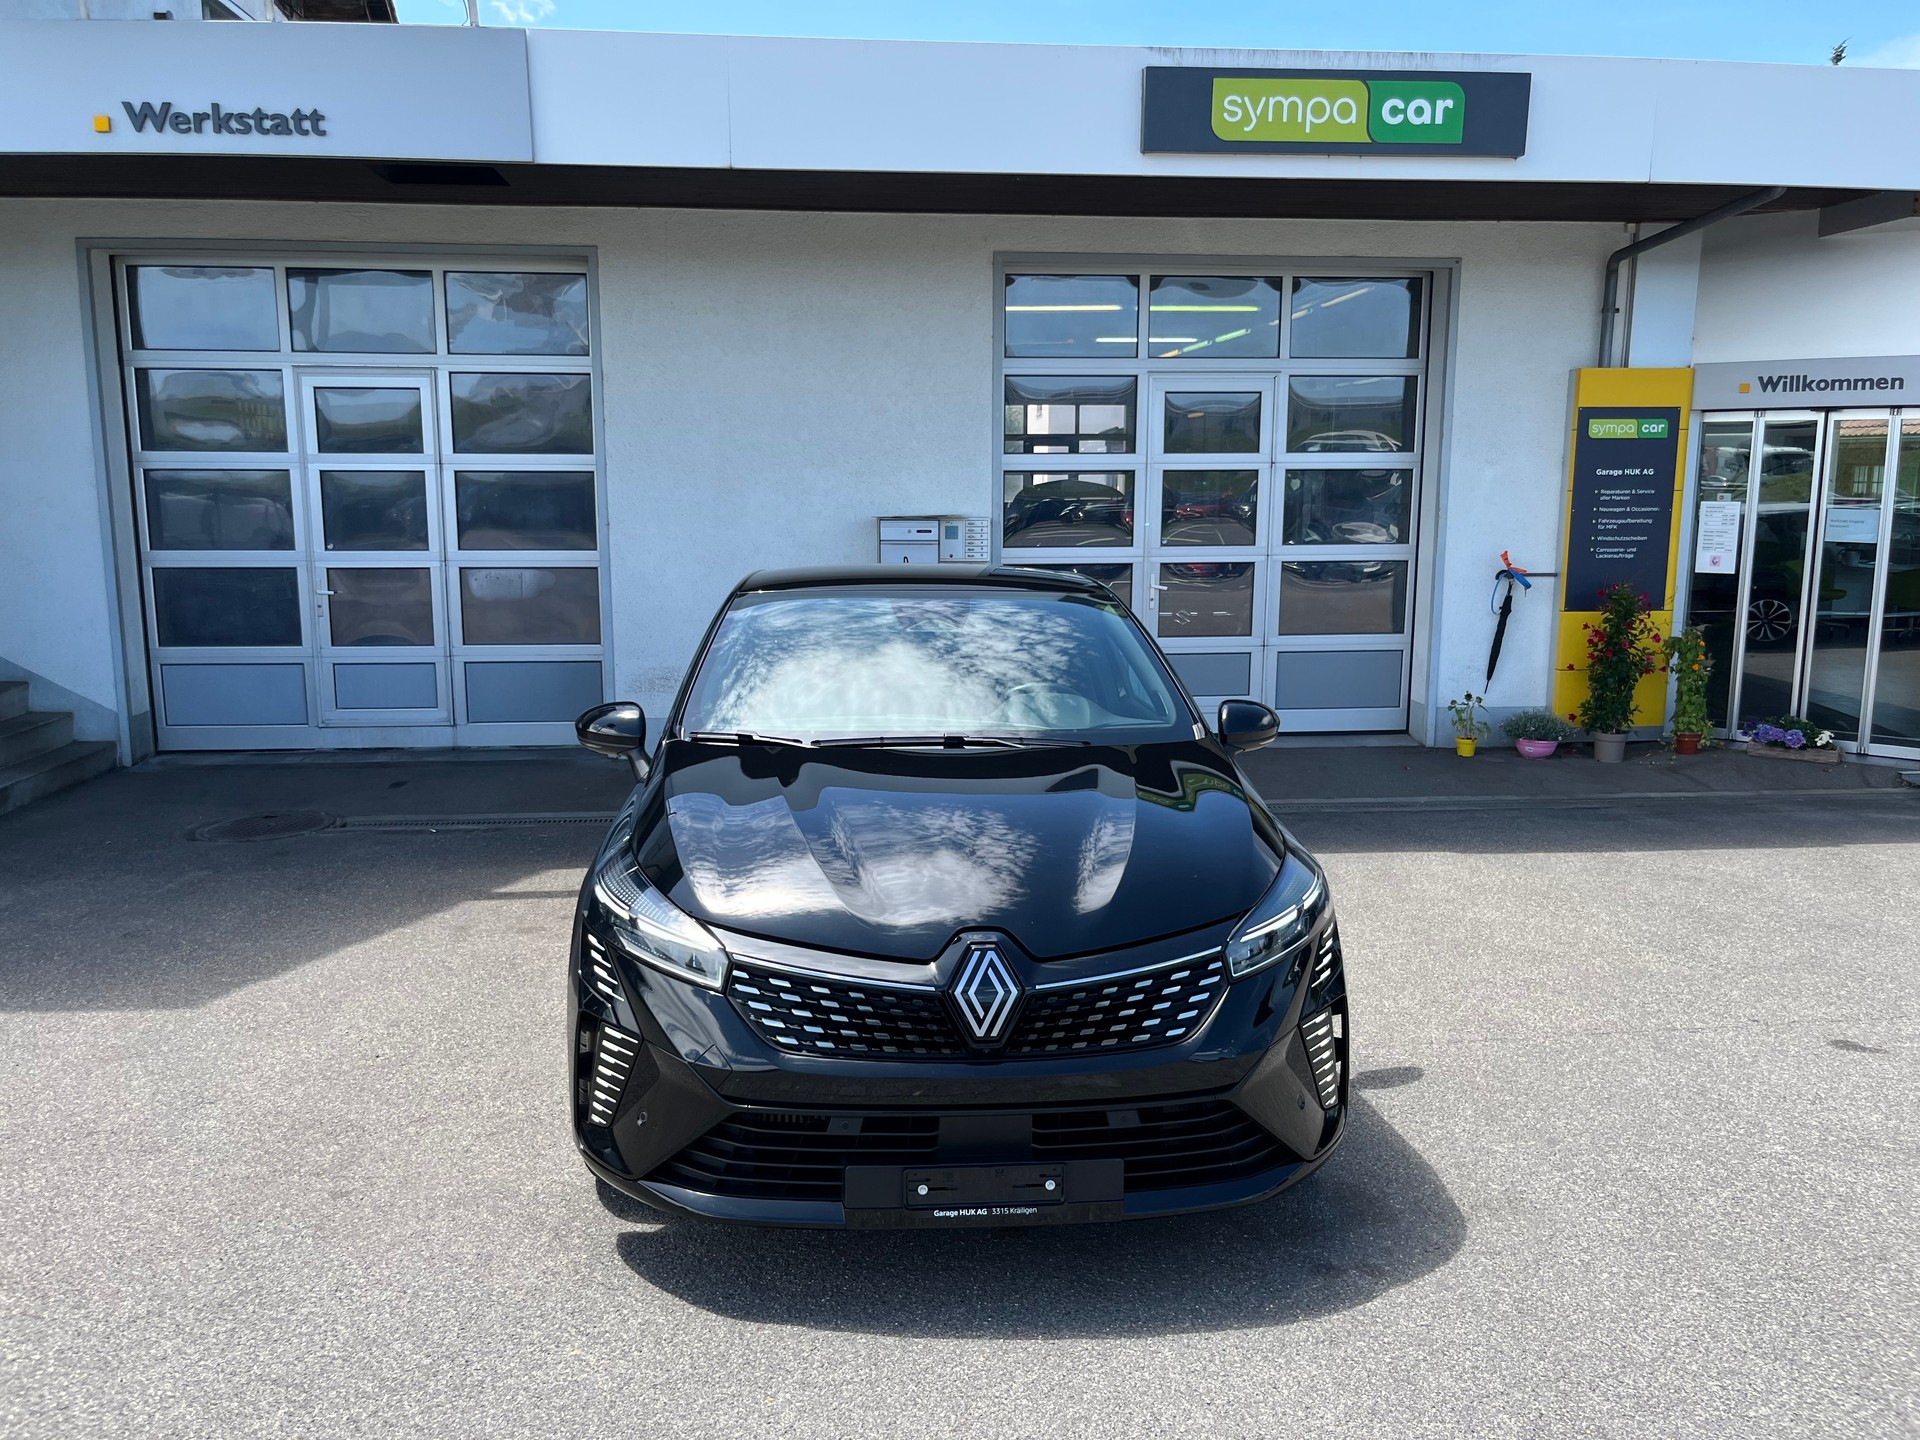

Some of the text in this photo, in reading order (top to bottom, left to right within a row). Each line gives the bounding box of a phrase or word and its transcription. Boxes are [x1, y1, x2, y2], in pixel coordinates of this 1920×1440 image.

[121, 101, 328, 137] Werkstatt
[1222, 94, 1455, 134] sympa car
[1757, 374, 1905, 393] Willkommen
[1591, 423, 1665, 436] sympa car
[1595, 468, 1655, 477] Garage HUK AG
[933, 1209, 959, 1218] Garage
[959, 1208, 976, 1216] HUK
[976, 1208, 988, 1216] AG
[991, 1207, 1009, 1215] 3315
